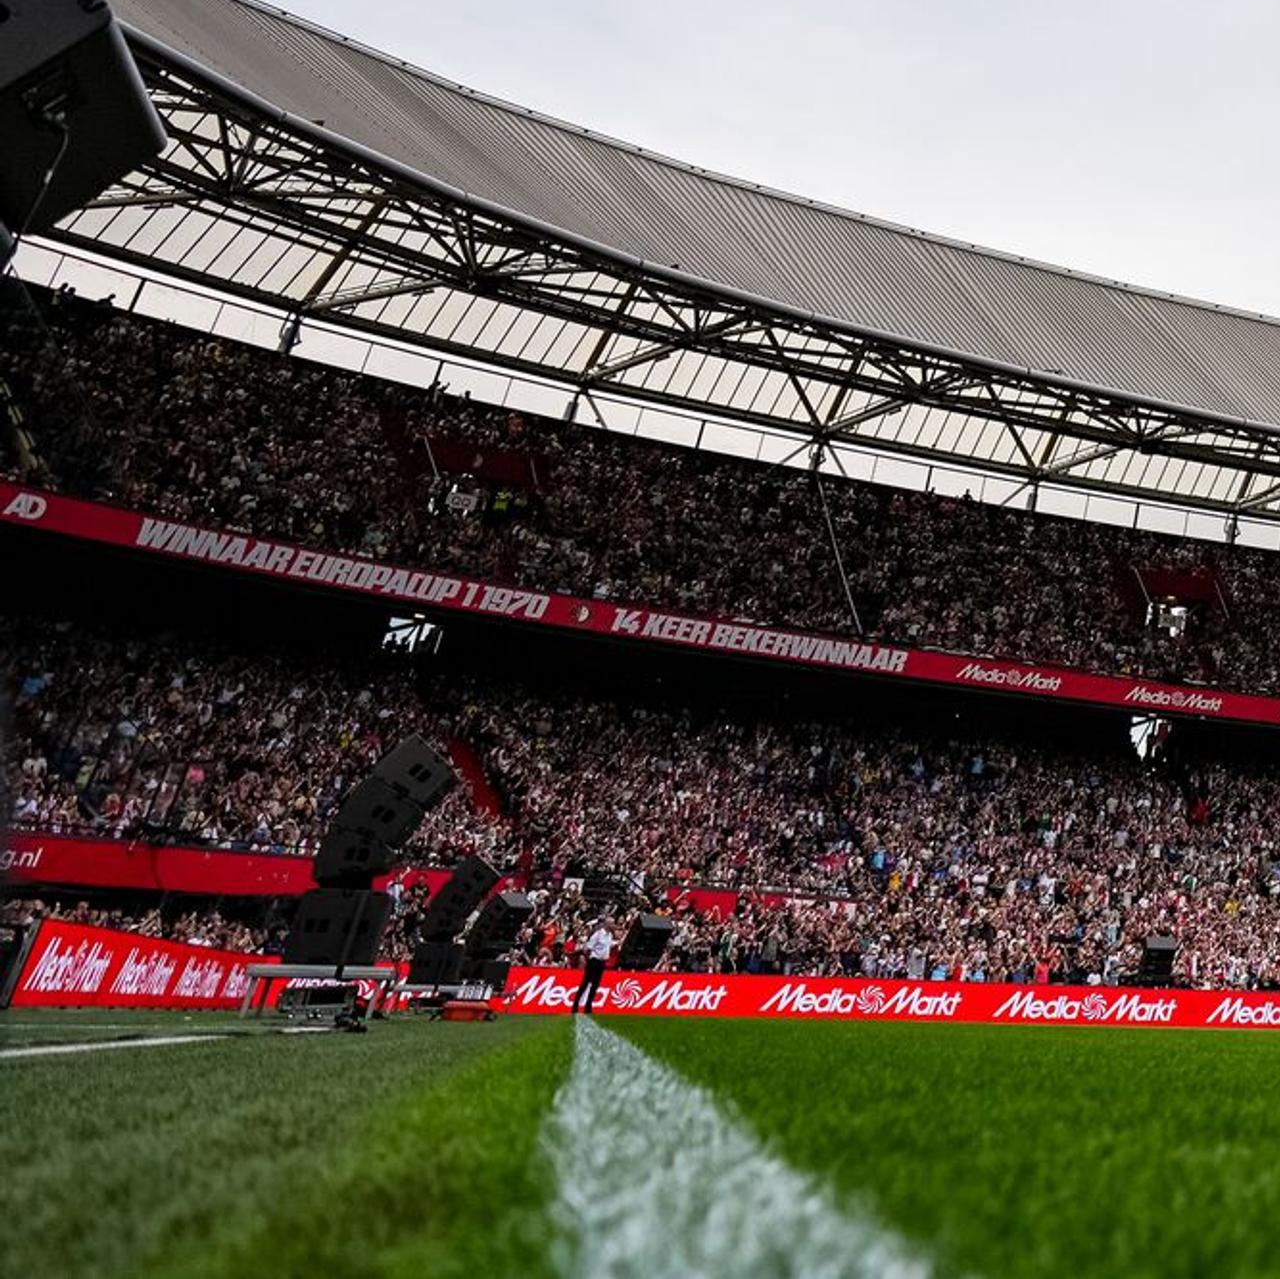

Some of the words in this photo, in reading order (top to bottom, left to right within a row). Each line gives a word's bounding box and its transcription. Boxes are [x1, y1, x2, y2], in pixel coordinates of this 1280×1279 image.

[2, 493, 47, 519] AD
[136, 518, 295, 574] WINNAAR
[288, 551, 461, 602] EUROPACUP
[610, 608, 641, 633] 14
[643, 614, 713, 643] KEER
[709, 624, 908, 672] BEKERWINNAAR
[956, 663, 1006, 683] Media
[1017, 672, 1061, 691] Markt
[1125, 686, 1170, 704] Media
[1181, 694, 1222, 711] Markt
[635, 980, 727, 1010] Markt
[760, 984, 856, 1013] Media
[878, 988, 962, 1016] Markt
[993, 992, 1080, 1020] Media
[1100, 995, 1177, 1022] Markt
